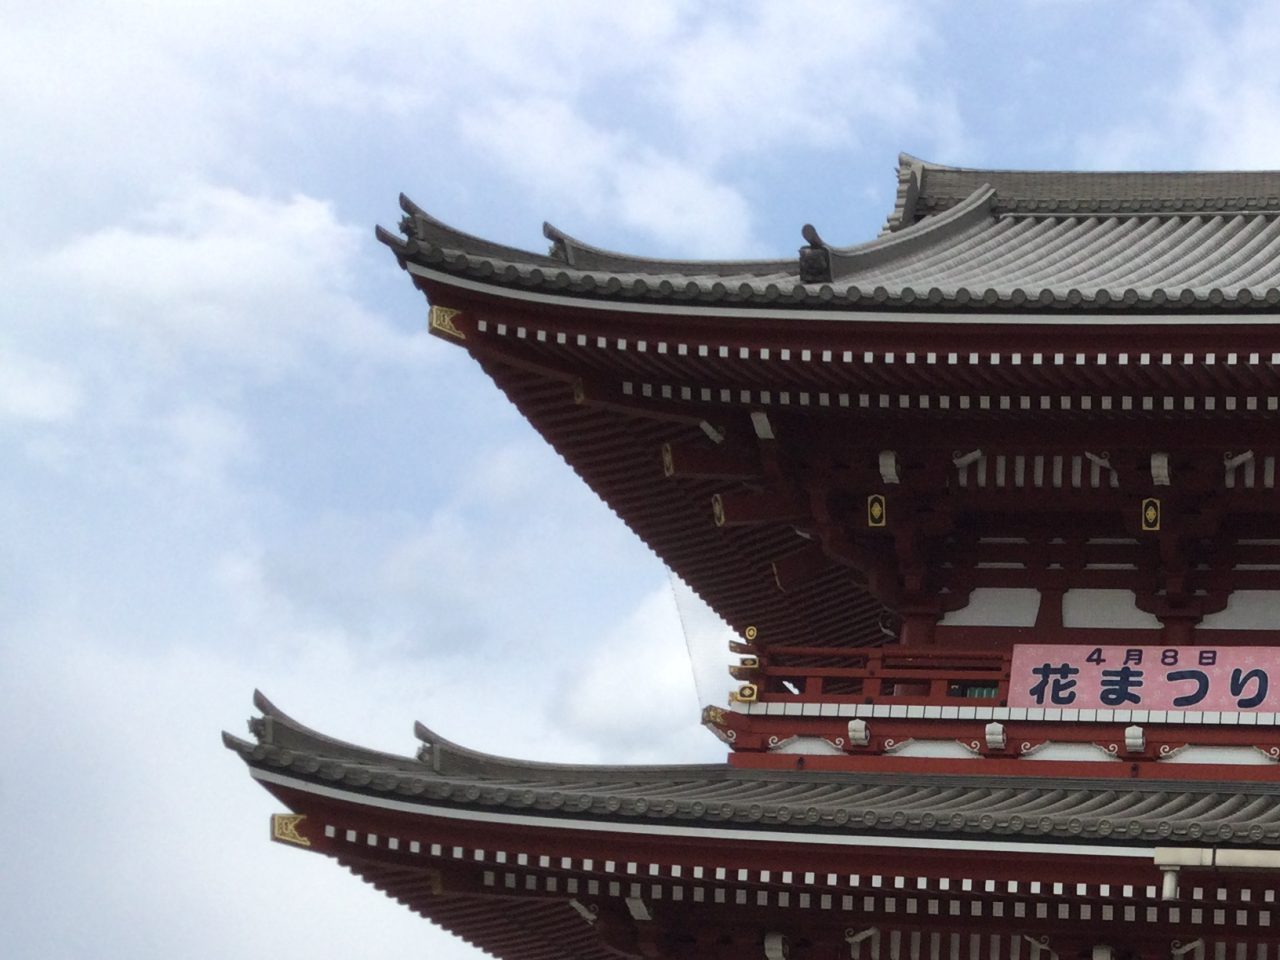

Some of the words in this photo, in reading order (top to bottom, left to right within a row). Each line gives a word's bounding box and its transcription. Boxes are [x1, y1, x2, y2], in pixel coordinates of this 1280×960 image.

[1085, 648, 1217, 666] 4月8日
[1029, 663, 1269, 708] 花まつり
